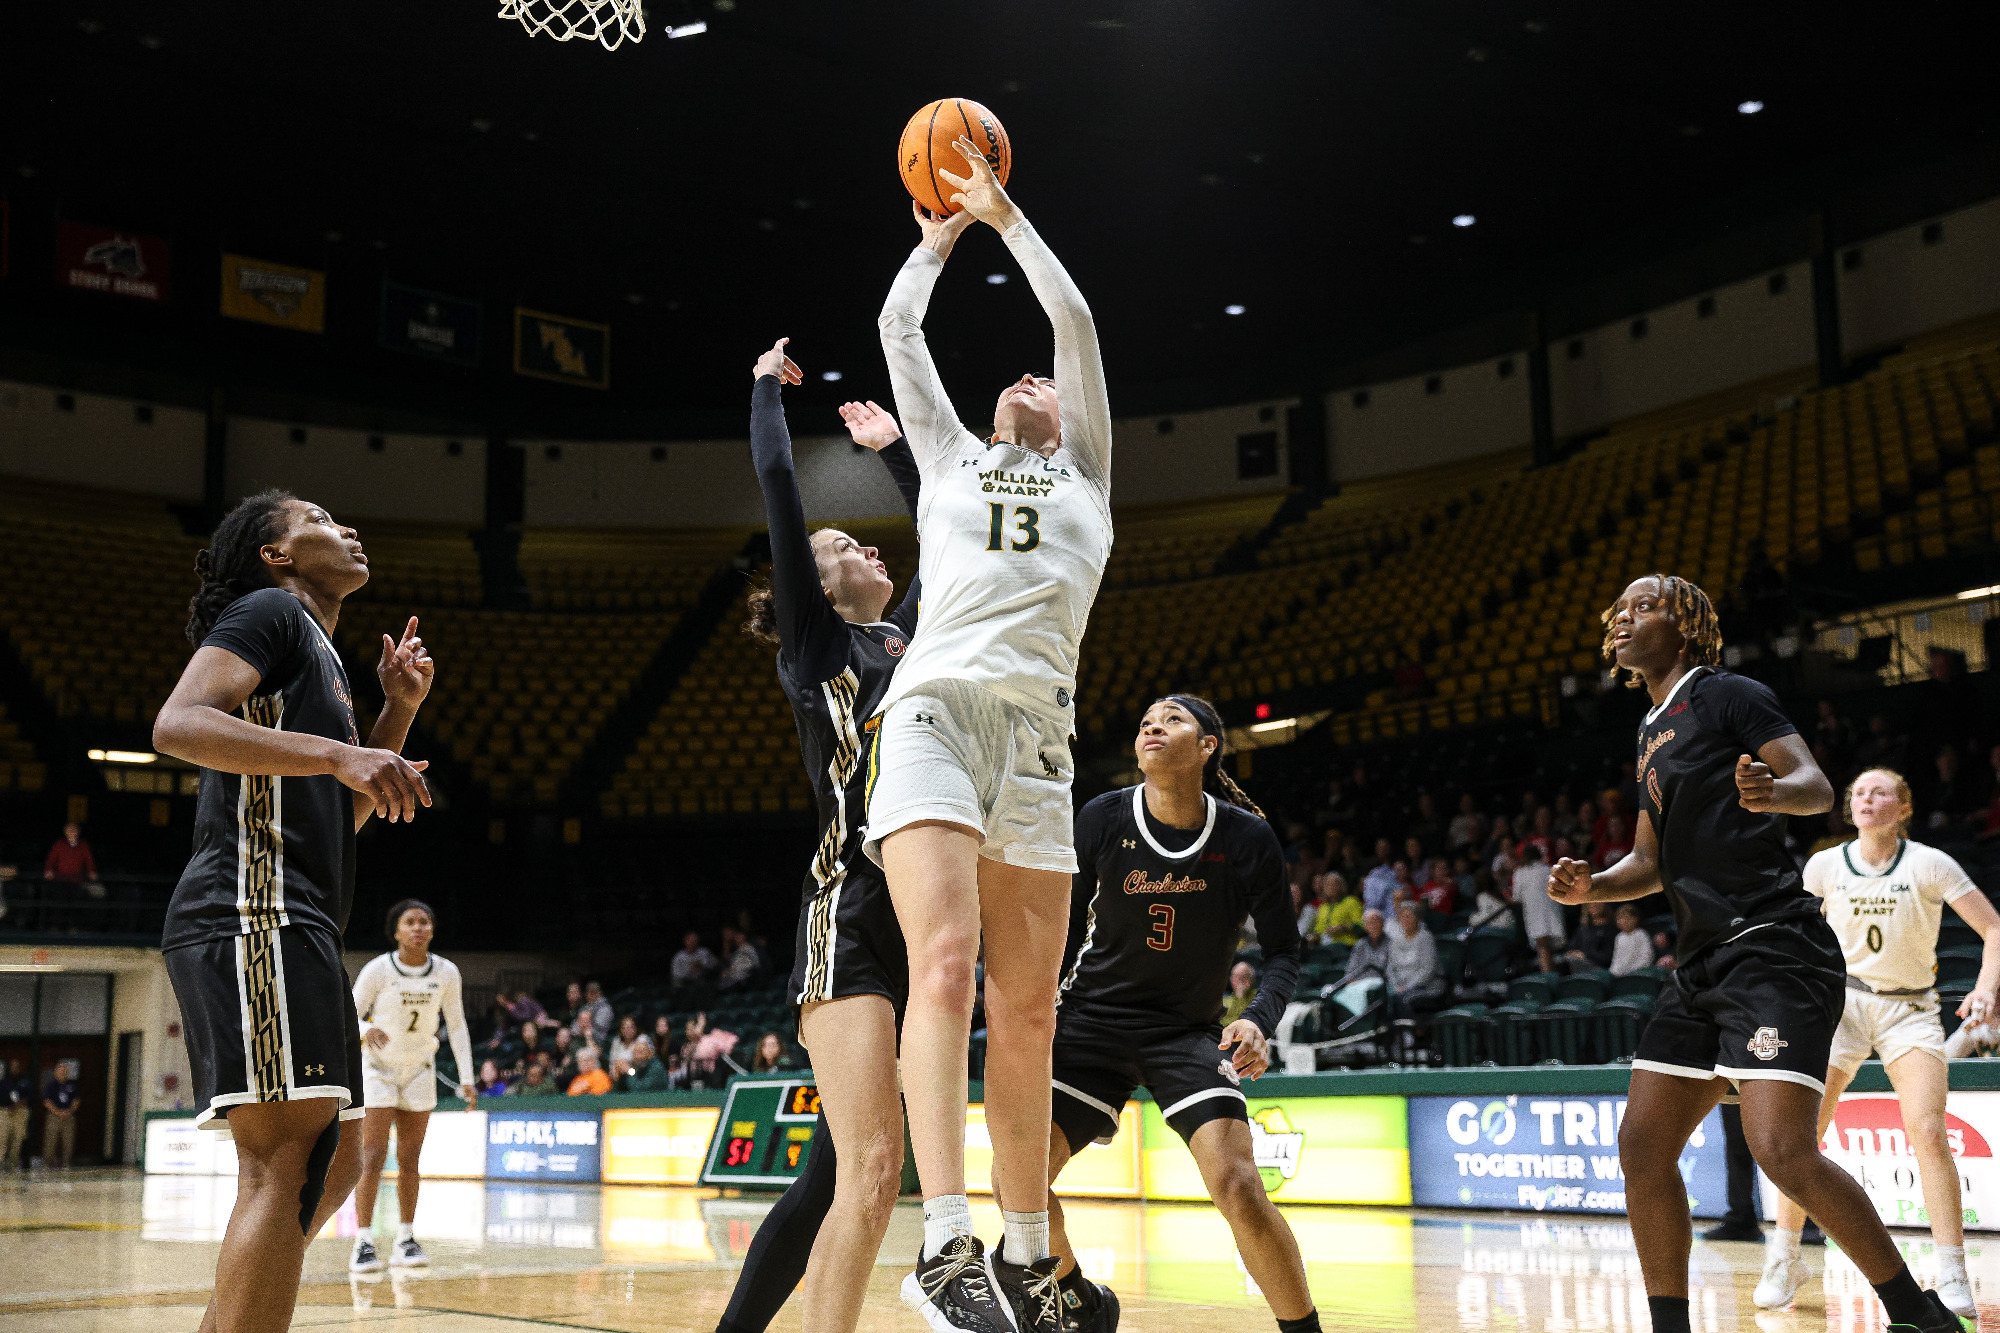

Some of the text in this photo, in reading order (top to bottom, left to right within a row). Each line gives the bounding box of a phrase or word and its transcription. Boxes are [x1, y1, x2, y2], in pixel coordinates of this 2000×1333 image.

[978, 469, 1055, 487] WILLIAM
[985, 501, 1041, 553] 13
[1123, 869, 1207, 895] Charleston
[1146, 903, 1175, 952] 3
[1866, 924, 1883, 954] 0
[407, 1010, 419, 1031] 2
[1446, 1099, 1517, 1146] GO
[1453, 1152, 1587, 1180] TOGETHER
